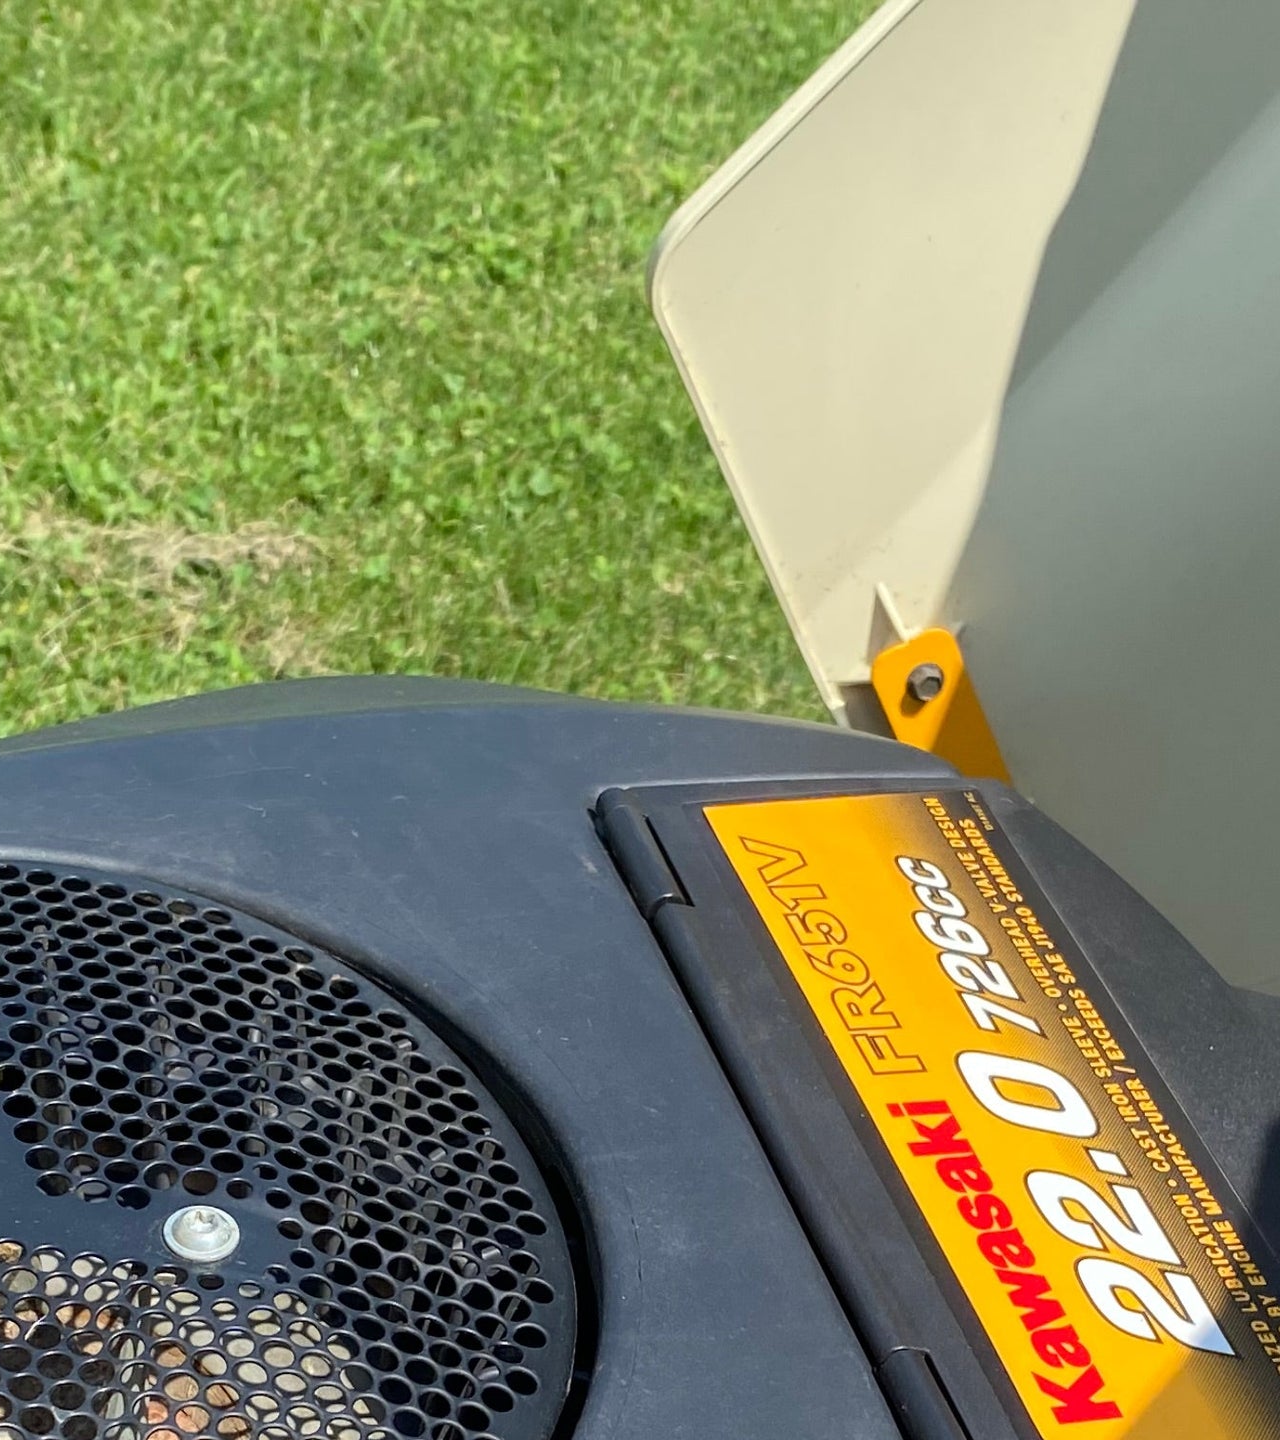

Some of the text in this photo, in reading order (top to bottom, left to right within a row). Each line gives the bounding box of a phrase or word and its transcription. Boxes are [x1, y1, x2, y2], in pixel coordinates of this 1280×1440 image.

[923, 798, 966, 847] DESIGN
[957, 852, 1005, 911] V-VALVE
[958, 819, 1022, 901] STANDARDS
[1000, 918, 1062, 997] OVERHEAD
[1015, 908, 1053, 948] J1940
[1045, 954, 1076, 983] SAE
[1062, 1017, 1111, 1076] SLEEVE
[1067, 989, 1125, 1059] EXCEEDS
[1113, 1065, 1135, 1073] /
[738, 836, 1123, 1424] Kawasaki FR651V
[896, 855, 1236, 1356] 22.0 726cc
[1103, 1083, 1139, 1120] IRON
[1124, 1078, 1222, 1214] MANUFACTURER
[1131, 1128, 1170, 1171] CAST
[1172, 1194, 1257, 1310] LUBRICATION
[1212, 1221, 1266, 1285] ENGINE
